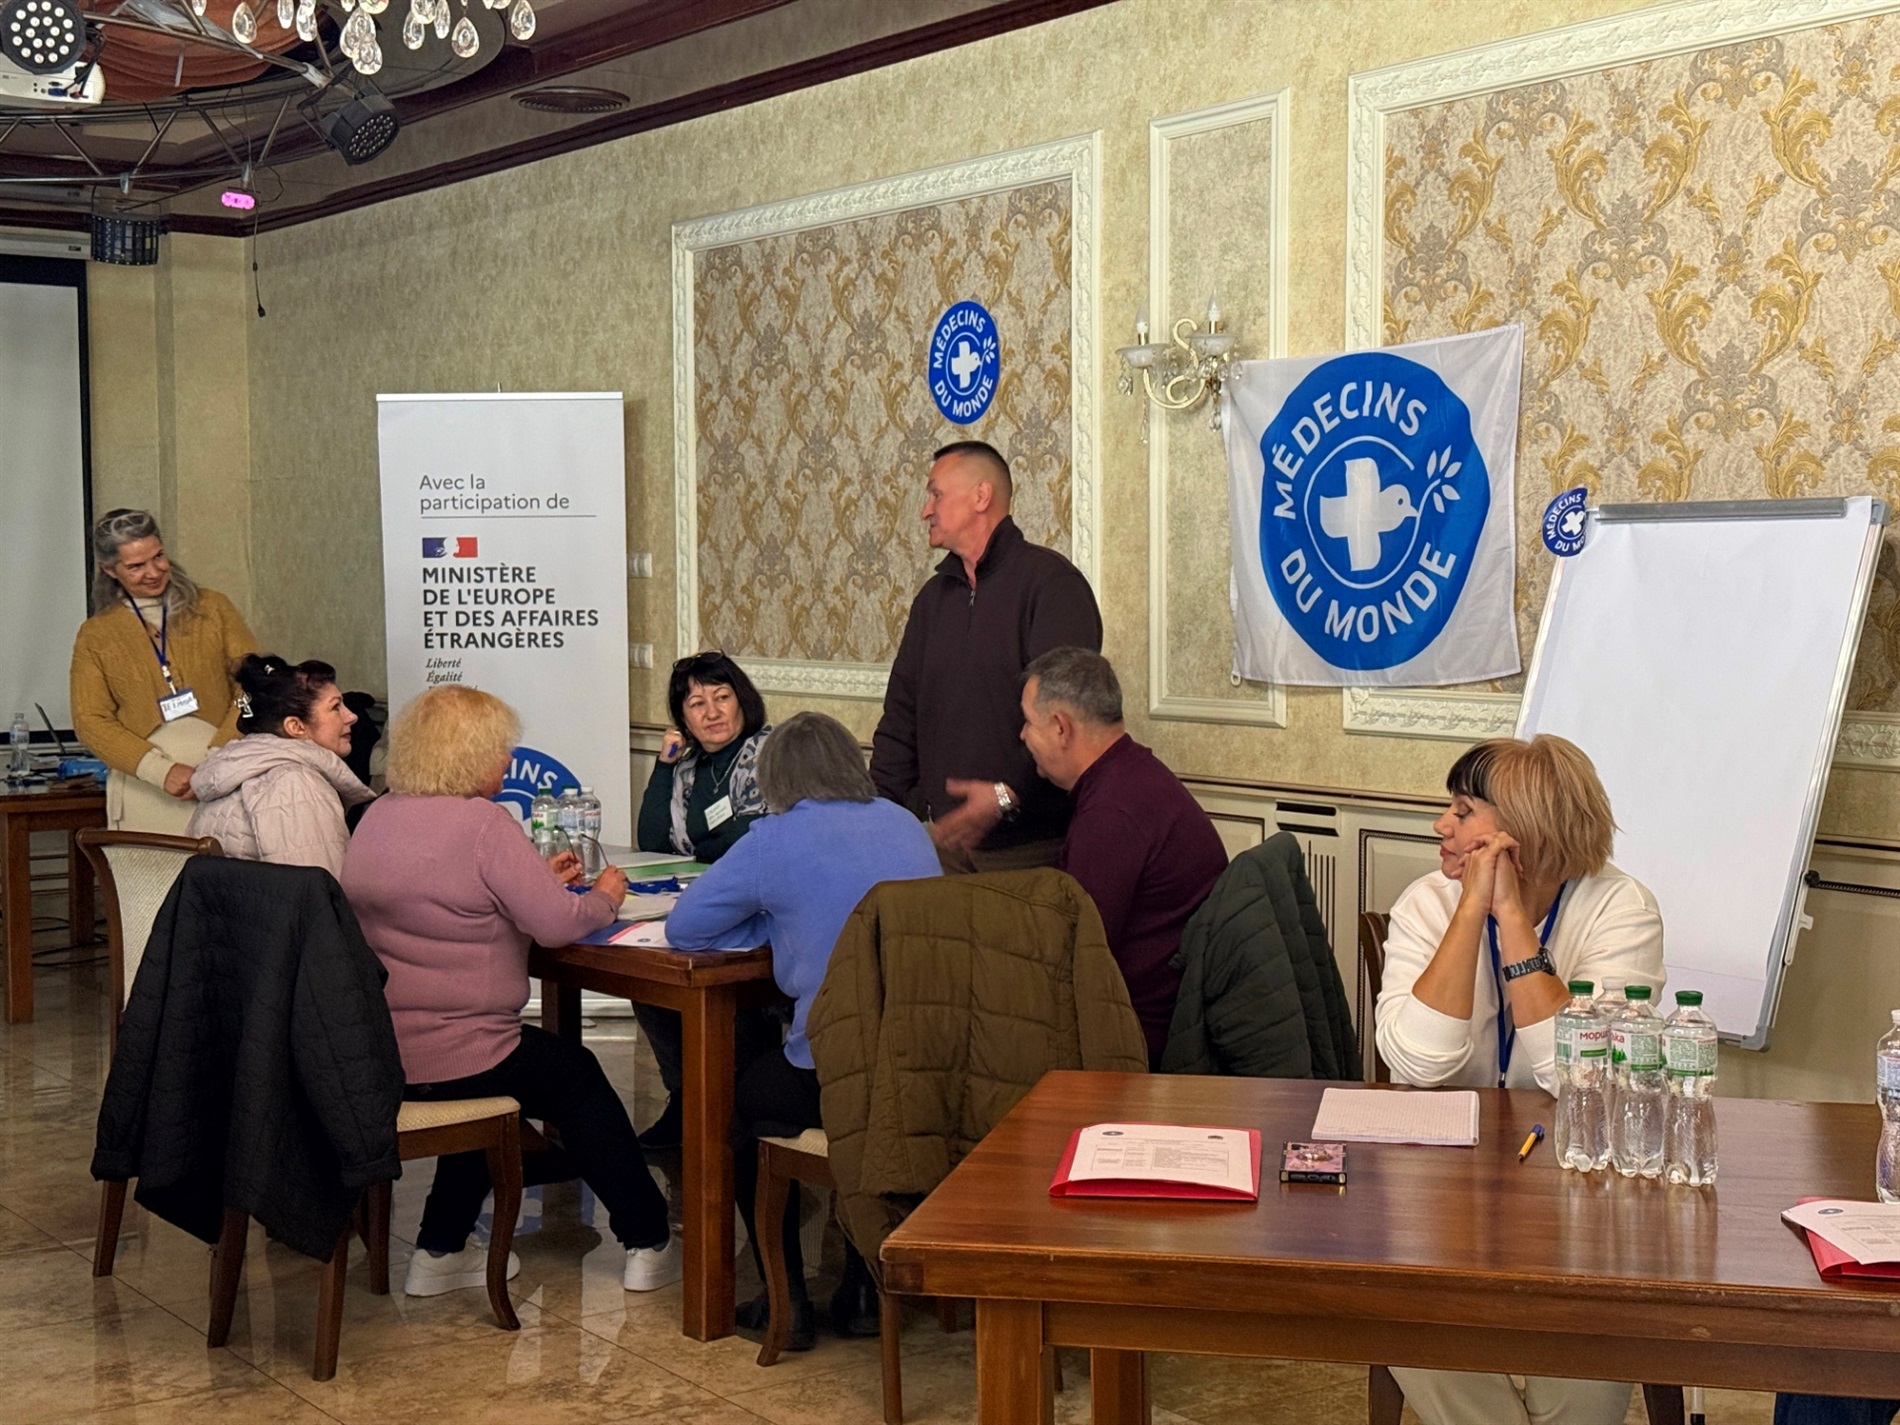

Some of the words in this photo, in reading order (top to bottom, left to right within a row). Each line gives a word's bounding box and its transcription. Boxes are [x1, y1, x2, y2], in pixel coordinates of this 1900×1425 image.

[933, 309, 986, 368] MÉDECINS
[934, 379, 952, 407] DU
[952, 374, 993, 417] MONDE
[1272, 380, 1428, 520] MÉDECINS
[419, 475, 465, 490] Avec
[470, 473, 485, 490] la
[420, 493, 540, 515] participation
[546, 493, 570, 509] de
[1554, 539, 1570, 552] DU
[422, 563, 537, 584] MINISTÈRE
[423, 589, 450, 605] DE
[457, 588, 556, 605] L'EUROPE
[1280, 548, 1323, 614] DU
[1324, 542, 1457, 643] MONDE
[424, 611, 448, 627] ET
[455, 610, 495, 627] DES
[501, 609, 599, 627] AFFAIRES
[424, 628, 565, 649] ÉTRANGÈRES
[425, 657, 462, 668] Liberté
[425, 670, 463, 684] Égalité
